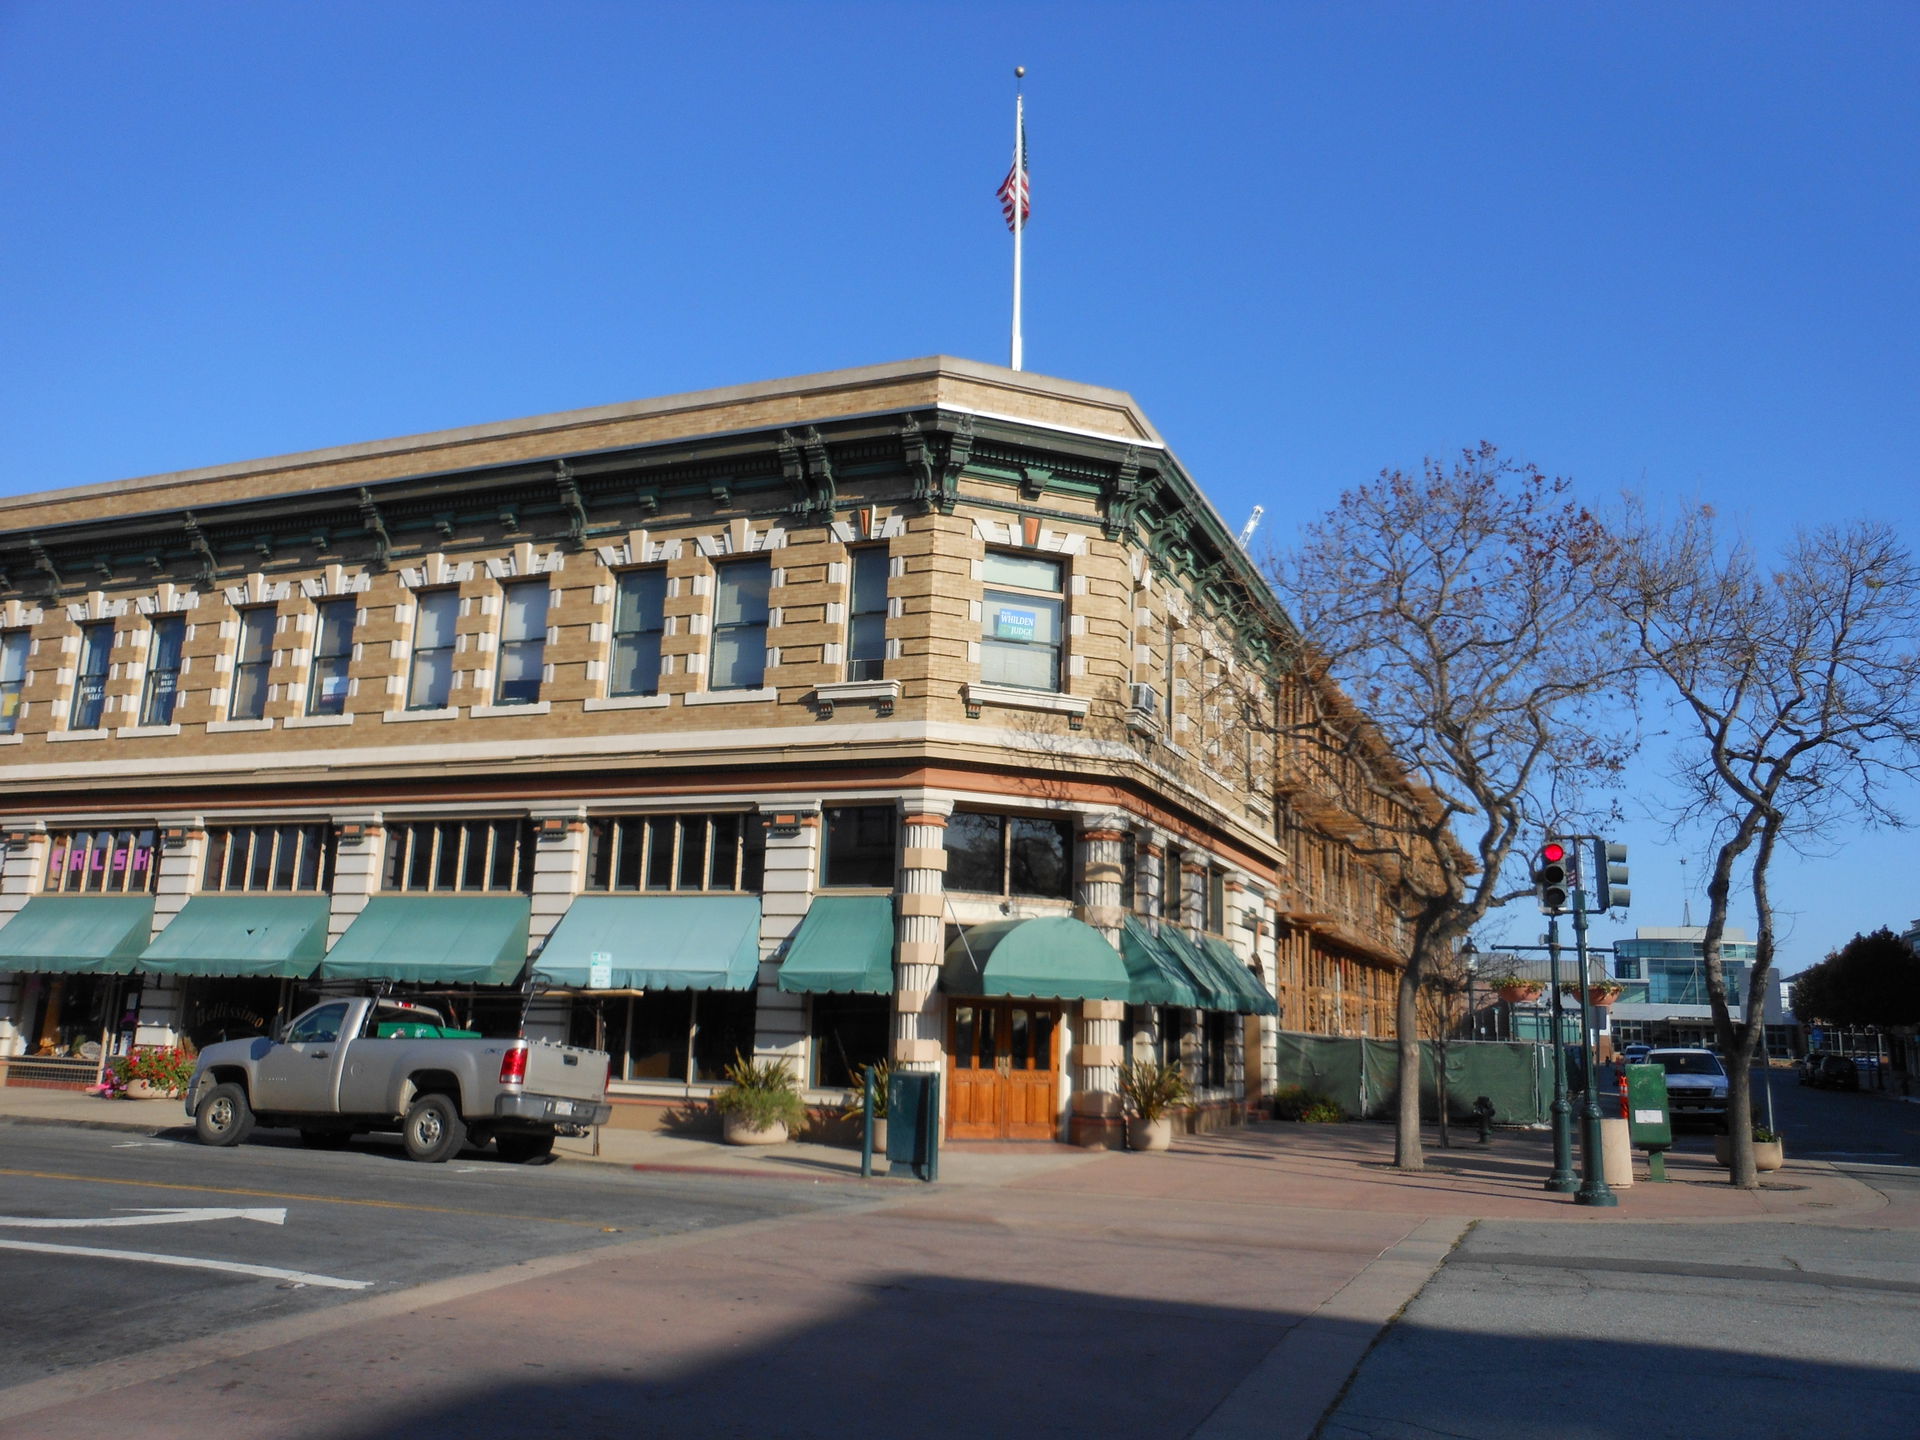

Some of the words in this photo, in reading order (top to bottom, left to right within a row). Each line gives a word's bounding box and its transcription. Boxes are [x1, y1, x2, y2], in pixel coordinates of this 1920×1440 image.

[1001, 614, 1034, 626] WHILDEN
[1011, 626, 1033, 637] JUDGE
[196, 1001, 264, 1028] Bellissimo
